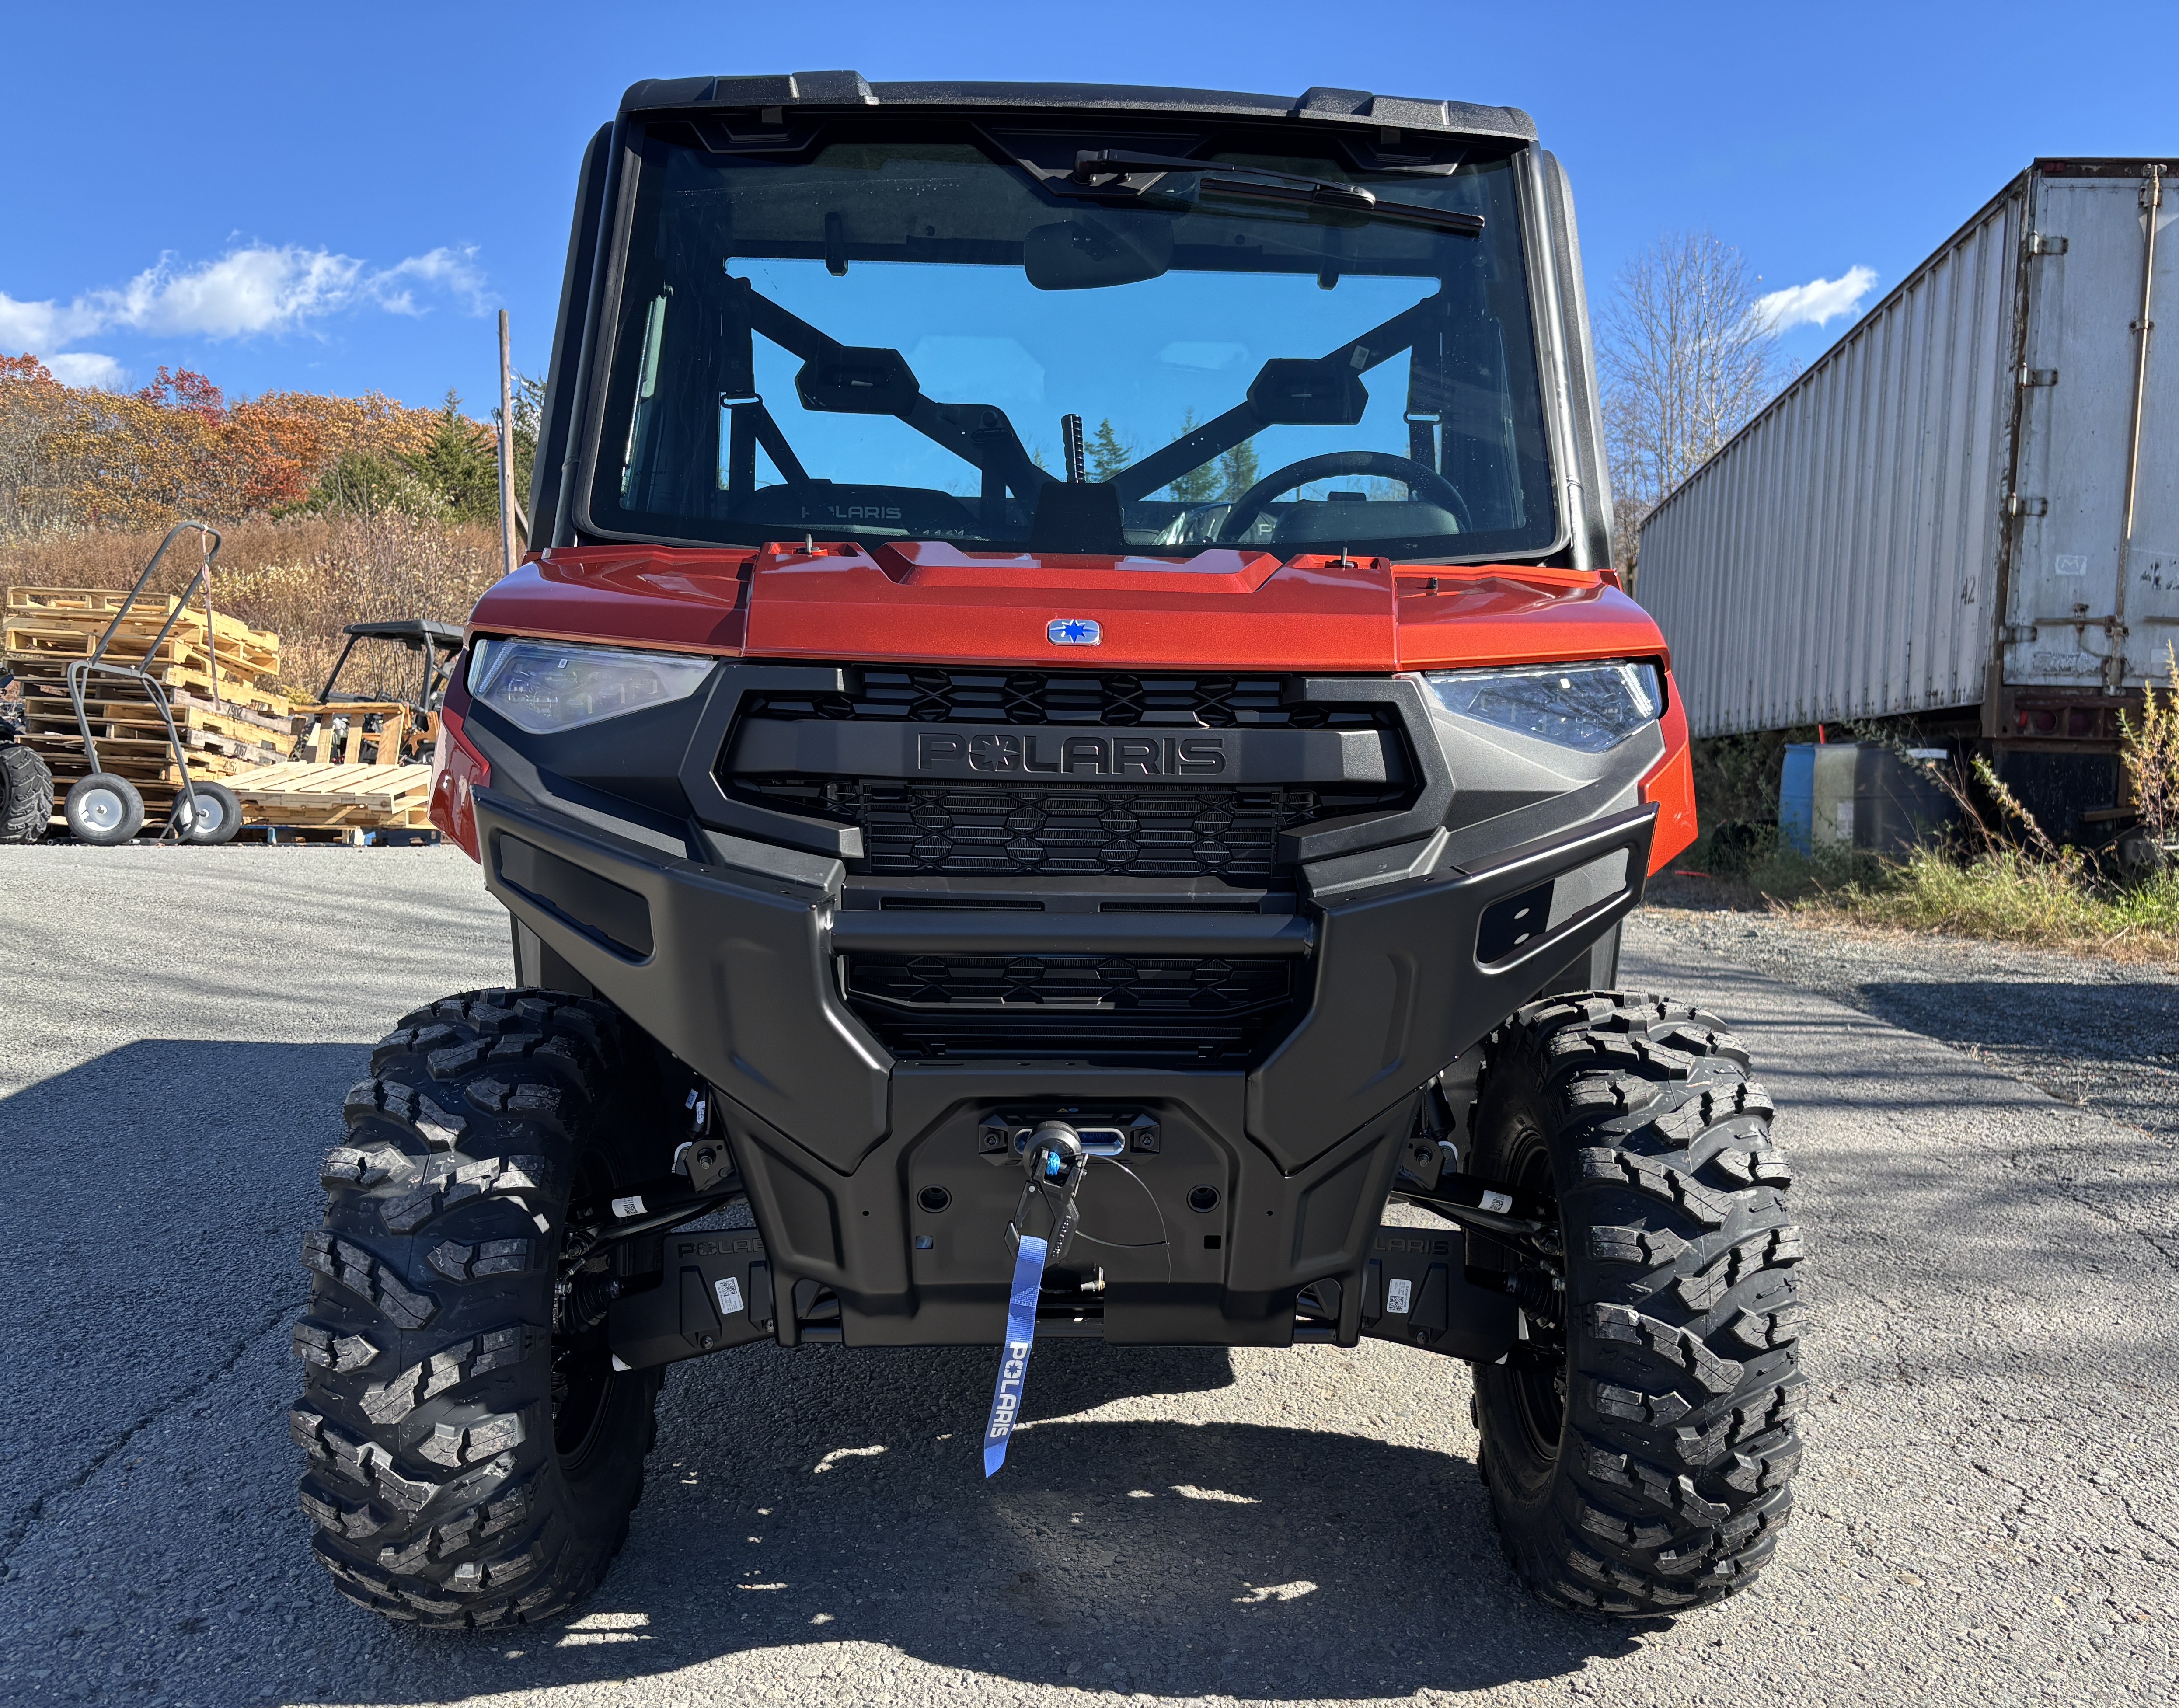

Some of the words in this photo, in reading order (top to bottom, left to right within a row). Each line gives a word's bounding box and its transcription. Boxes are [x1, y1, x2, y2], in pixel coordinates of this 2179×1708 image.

[802, 505, 902, 519] LARIS
[918, 733, 1226, 776] POLARIS
[678, 1238, 764, 1258] POLAR
[1374, 1237, 1449, 1255] LARIS
[990, 1342, 1028, 1438] POLARIS
